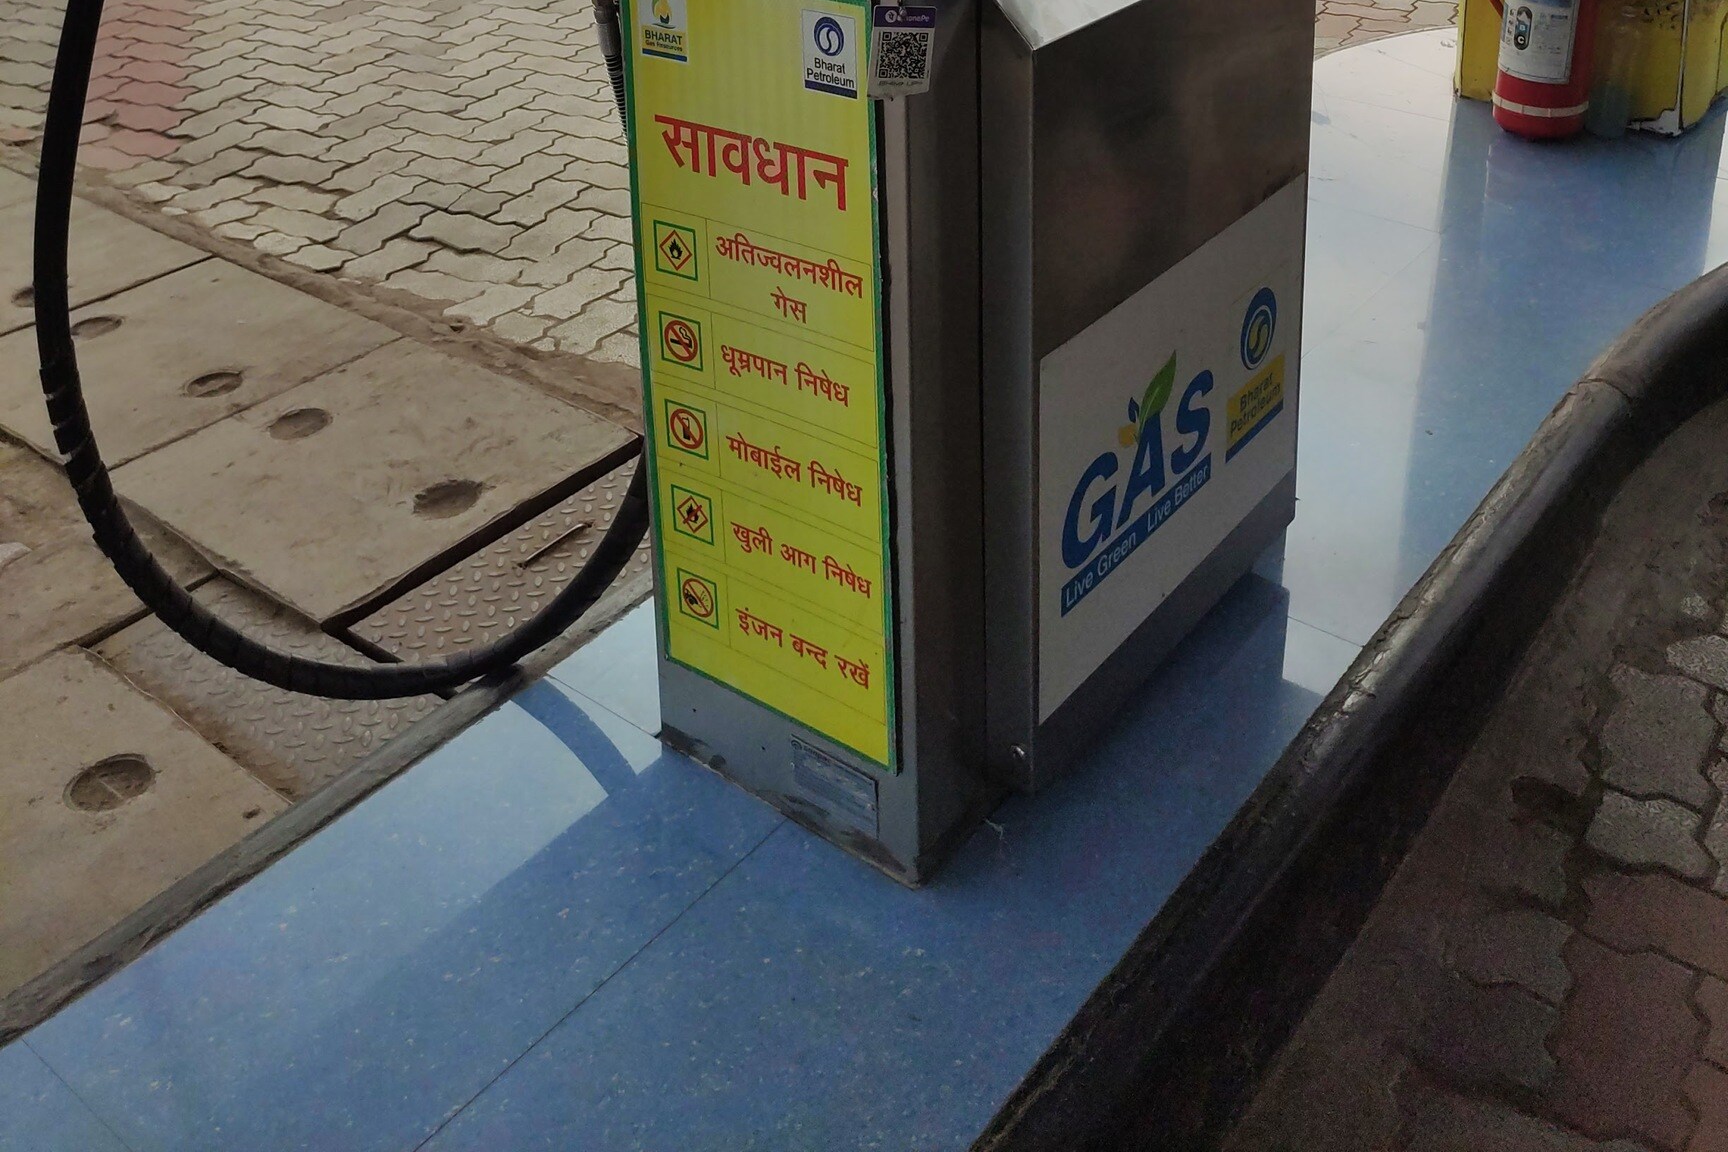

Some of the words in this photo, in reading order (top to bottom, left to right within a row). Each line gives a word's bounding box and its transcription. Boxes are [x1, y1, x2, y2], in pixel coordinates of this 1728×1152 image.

[645, 29, 683, 46] BHARAT
[814, 57, 846, 74] Bharat
[806, 67, 855, 88] Petroleum
[654, 114, 849, 212] सावधान
[715, 232, 864, 299] अतिज्वलनशील
[770, 285, 807, 324] गेस
[720, 344, 788, 385] धूम्रपान
[794, 362, 850, 407] निषेध
[1240, 372, 1273, 412] Bharat
[1230, 383, 1281, 436] Petroleum
[725, 432, 801, 482] मोबाईल
[807, 460, 863, 507] निषेध
[1061, 369, 1214, 569] GAS
[730, 521, 773, 555] खुली
[780, 543, 817, 574] आग
[822, 555, 872, 599] निषेध
[1065, 574, 1093, 608] Live
[1096, 531, 1136, 576] Green
[1146, 500, 1172, 531] Live
[1174, 465, 1209, 504] Better
[735, 607, 783, 648] इंजन
[789, 634, 828, 670] बन्द
[834, 659, 870, 690] रखें
